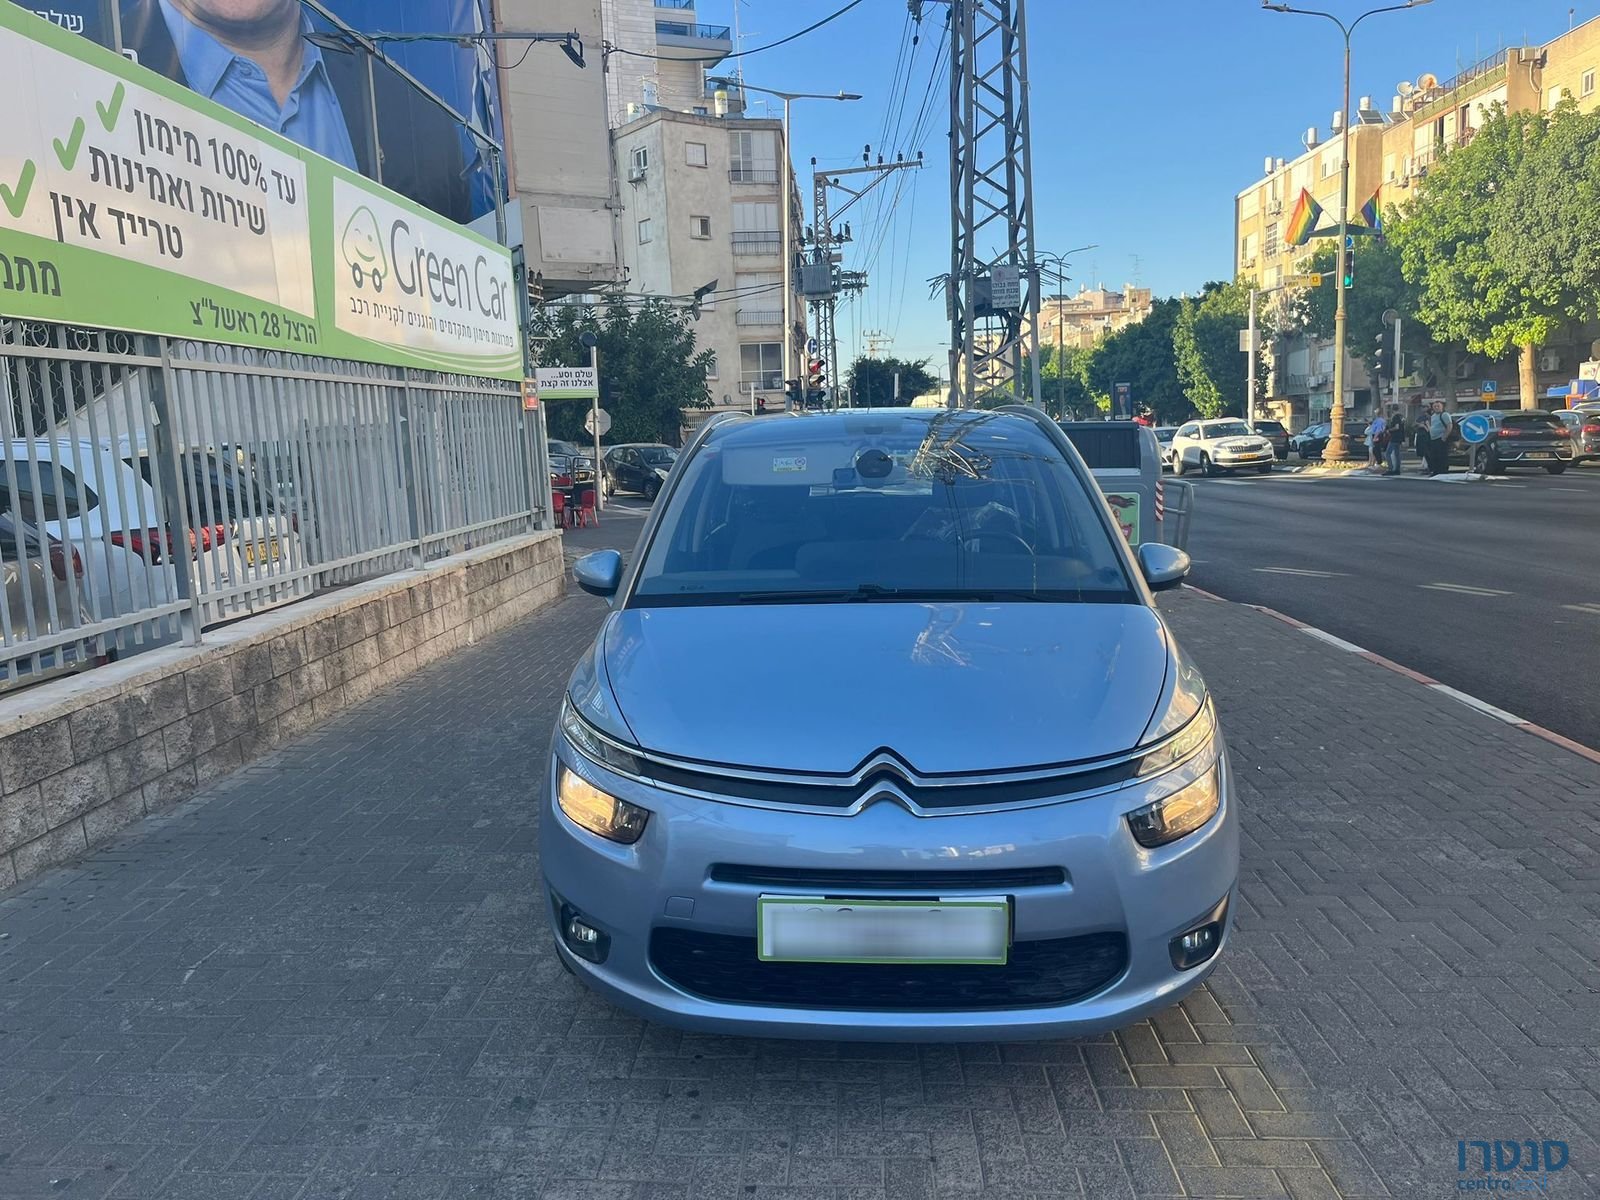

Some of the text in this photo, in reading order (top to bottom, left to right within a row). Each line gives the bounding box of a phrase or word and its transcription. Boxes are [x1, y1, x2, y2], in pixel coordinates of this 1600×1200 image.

[134, 109, 296, 205] עד 100% מימון
[88, 145, 266, 236] שירות ואמינות
[50, 191, 184, 259] טרייד אין
[390, 219, 508, 322] Green Car
[350, 297, 370, 316] רכב
[373, 302, 404, 327] לקניית
[261, 310, 281, 339] 28
[283, 317, 317, 345] הרצל
[408, 311, 437, 331] והוגנים
[440, 319, 472, 340] מתקדמים
[541, 380, 558, 389] קצת
[571, 379, 594, 387] אצלנו
[575, 370, 593, 378] שלם
